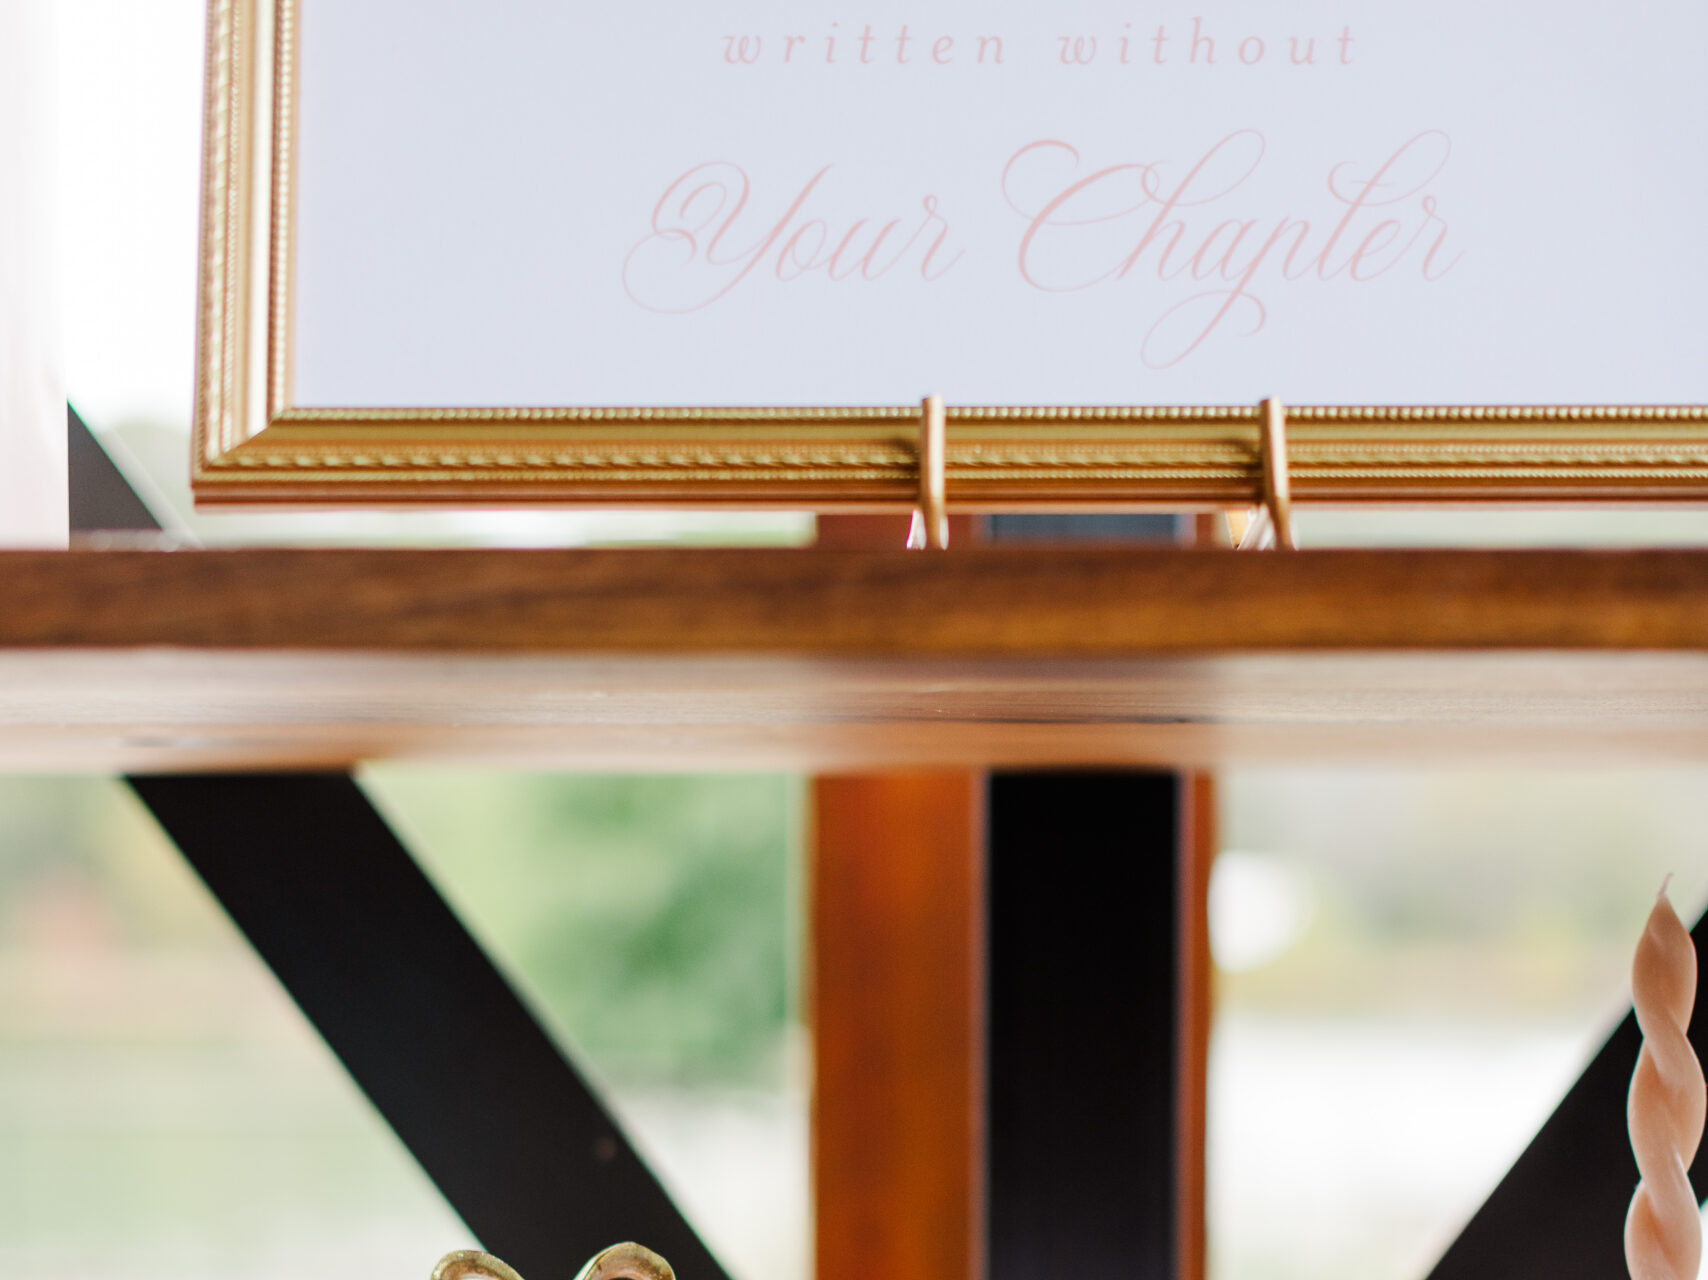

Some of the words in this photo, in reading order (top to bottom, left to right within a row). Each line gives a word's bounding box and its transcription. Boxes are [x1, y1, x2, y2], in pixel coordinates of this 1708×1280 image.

[721, 23, 1006, 66] written
[1057, 16, 1357, 66] without
[622, 160, 966, 315] Your
[1000, 128, 1466, 370] Chapter
